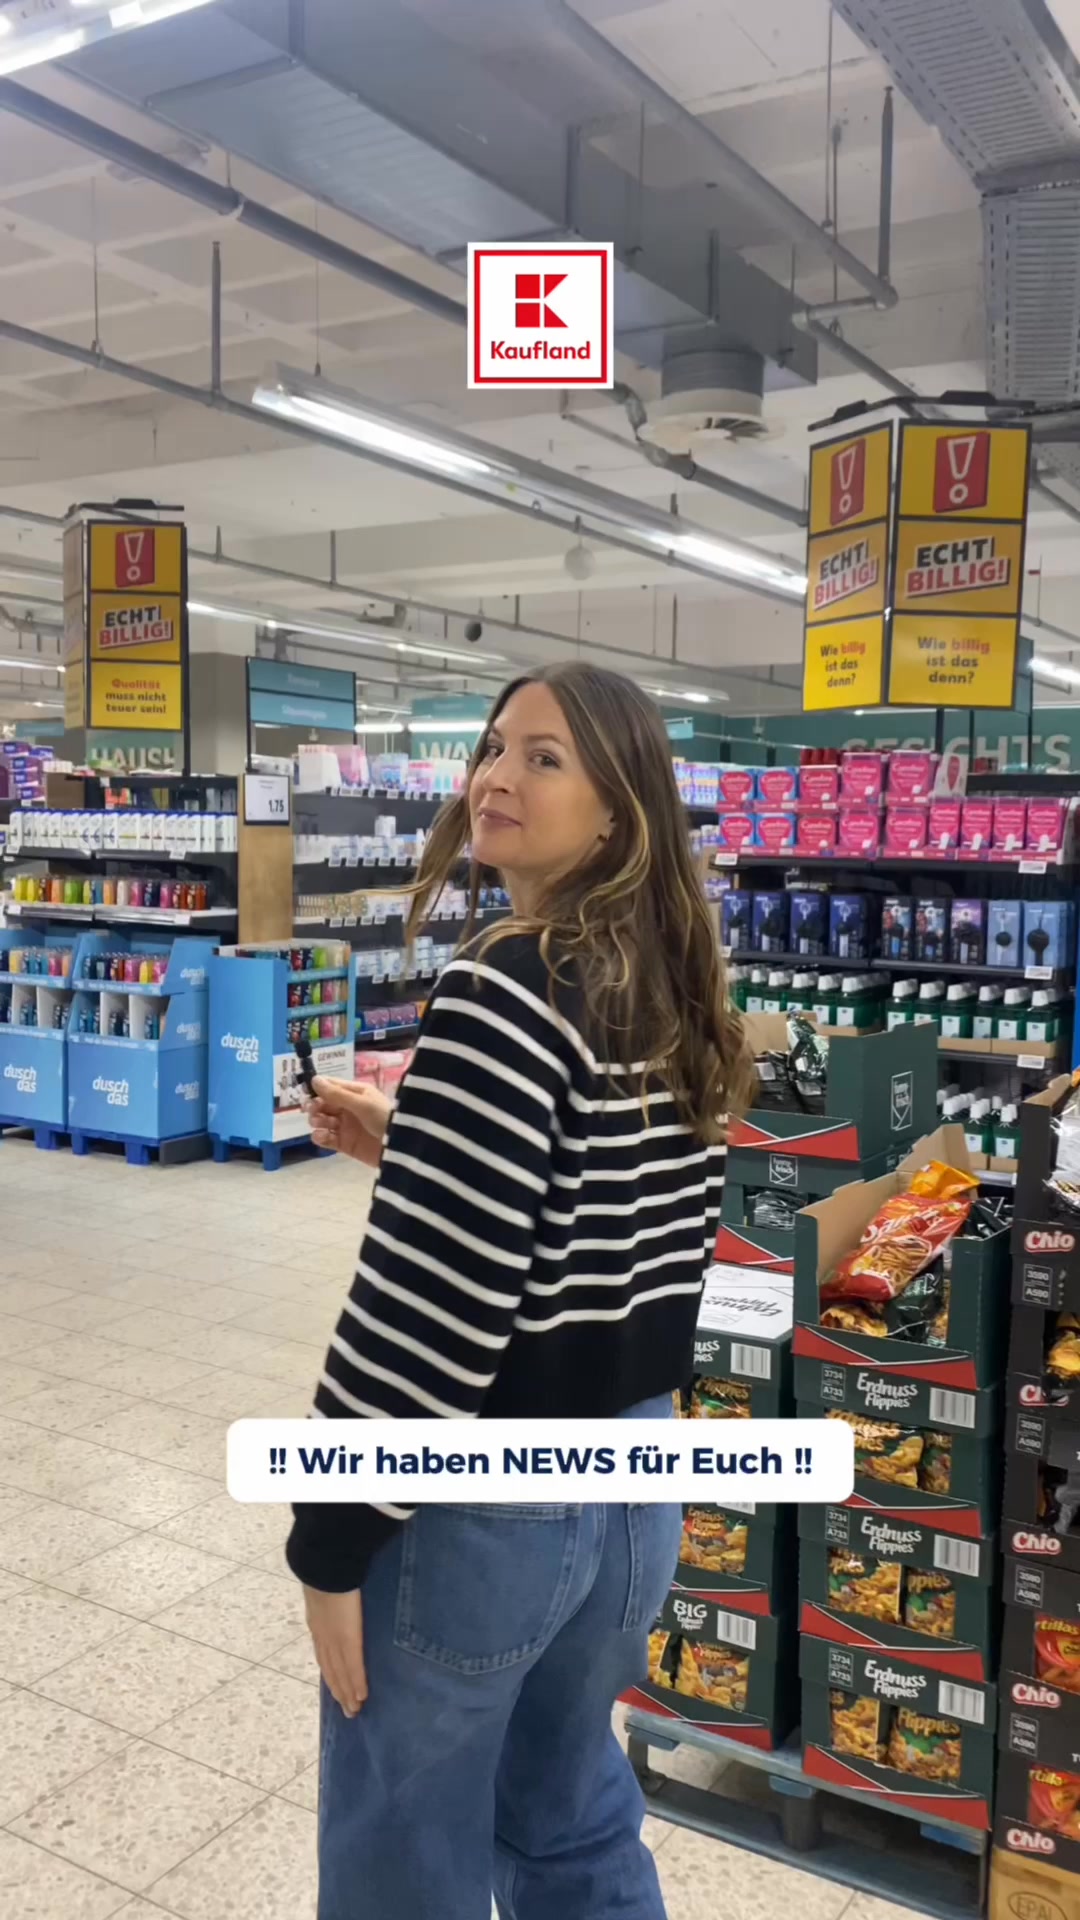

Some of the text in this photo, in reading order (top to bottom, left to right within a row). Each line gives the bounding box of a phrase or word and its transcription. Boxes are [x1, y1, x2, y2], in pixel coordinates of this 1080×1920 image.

[814, 562, 874, 604] BILLIG!
[907, 559, 1004, 592] BILLIG!
[100, 620, 169, 645] BILLIG!
[820, 641, 866, 657] Wie billig
[917, 636, 990, 655] Wie billig
[825, 658, 858, 672] ist das
[927, 656, 978, 667] ist das
[111, 679, 161, 690] Qualität
[827, 673, 856, 688] denn?
[929, 671, 974, 683] denn?
[105, 692, 166, 701] muss nicht
[106, 703, 166, 714] teuer sein!
[268, 799, 284, 813] 1.75
[221, 1032, 259, 1049] dusch
[236, 1049, 259, 1063] das
[4, 1063, 37, 1080] dusch
[17, 1079, 37, 1093] das
[92, 1076, 129, 1094] dusch
[107, 1091, 129, 1106] das
[1024, 1230, 1076, 1251] Chio
[824, 1368, 844, 1380] 3734
[823, 1387, 844, 1397] A733
[856, 1372, 919, 1399] Erdnuss
[864, 1393, 911, 1411] Flippies
[828, 1511, 848, 1523] 3734
[827, 1528, 848, 1539] A733
[860, 1516, 923, 1544] Erdnuss
[868, 1536, 915, 1556] Flippies
[1012, 1531, 1062, 1554] Chio
[673, 1599, 708, 1619] BIG
[831, 1653, 851, 1665] 3734
[831, 1670, 851, 1682] A733
[864, 1659, 928, 1688] Erdnuss
[873, 1681, 919, 1699] Flippies
[1011, 1683, 1061, 1707] Chio
[898, 1706, 962, 1737] Flippies
[1006, 1828, 1056, 1853] Chio
